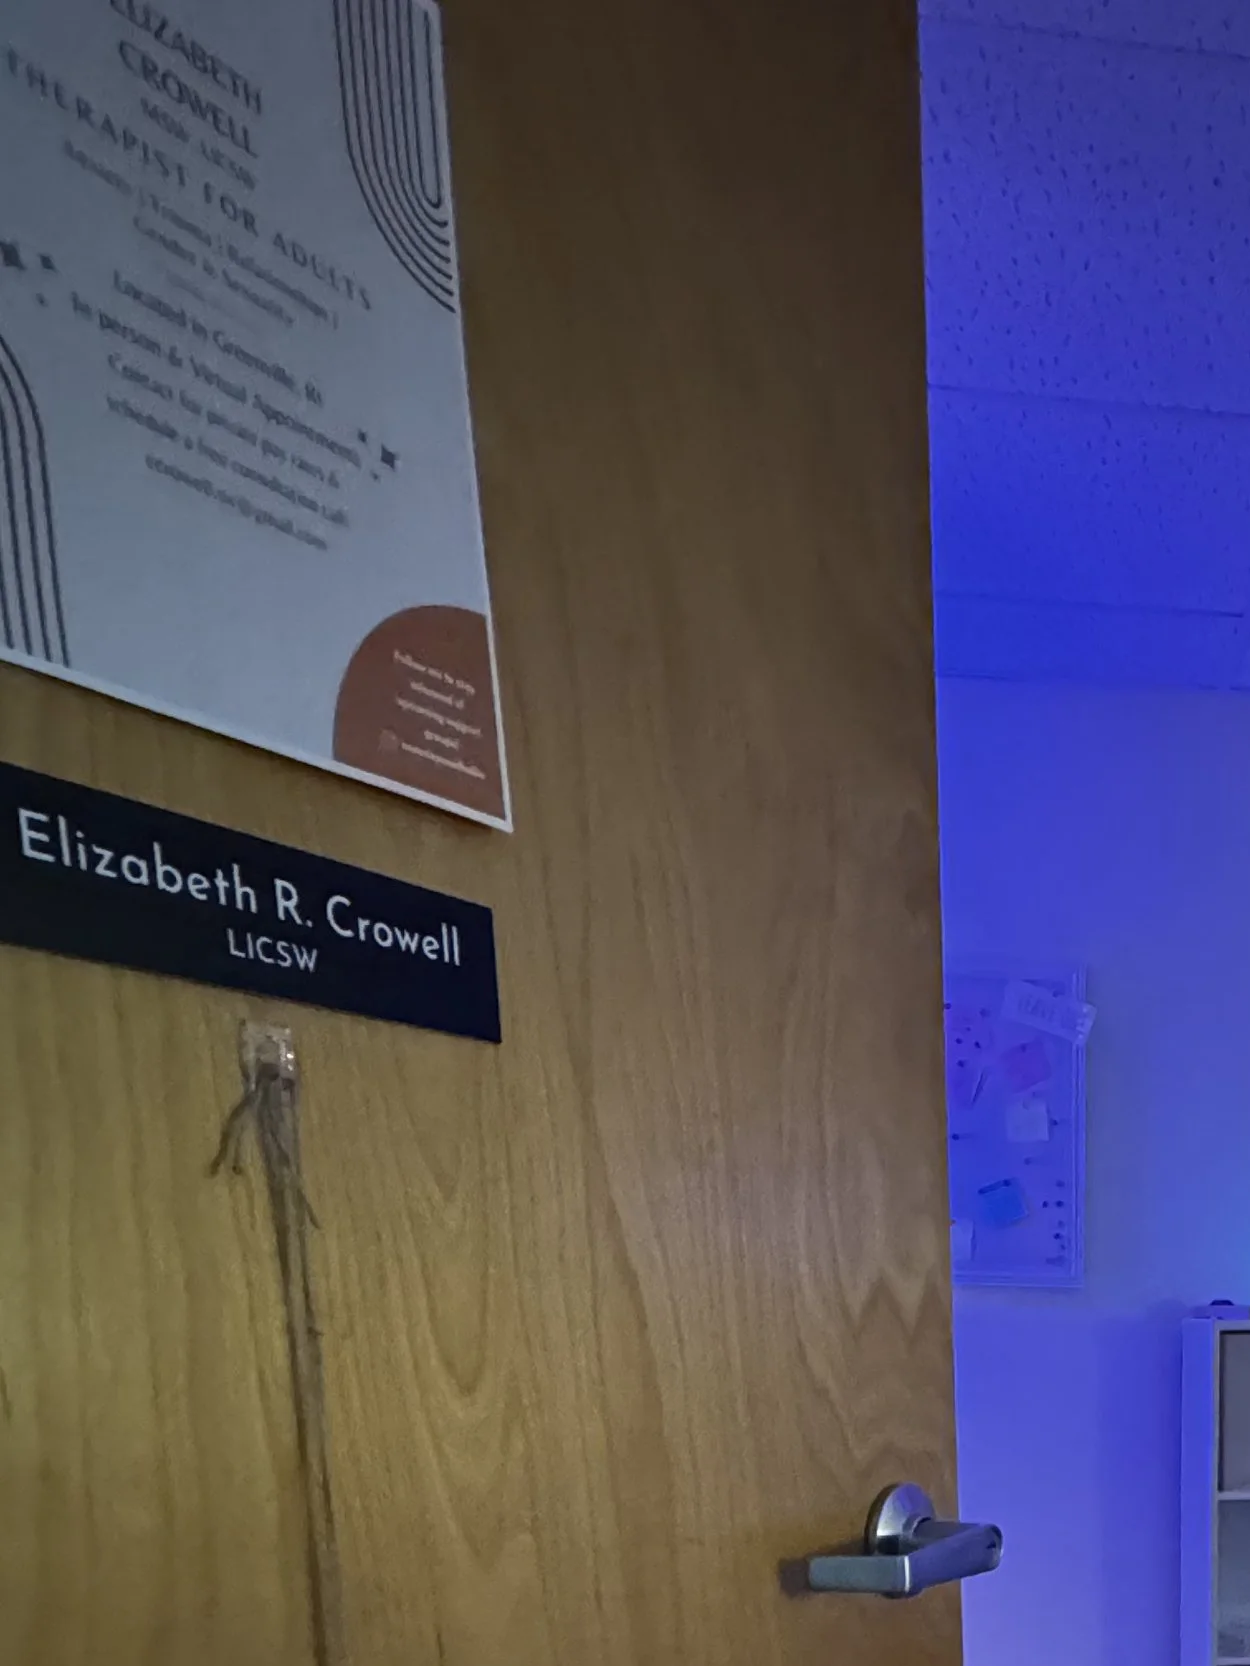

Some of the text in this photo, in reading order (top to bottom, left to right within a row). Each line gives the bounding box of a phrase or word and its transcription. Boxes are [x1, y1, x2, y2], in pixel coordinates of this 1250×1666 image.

[110, 0, 262, 116] LIZABETH
[119, 39, 260, 161] CROWELL
[18, 808, 461, 967] Elizabeth R. Crowell
[226, 928, 318, 973] LICSW
